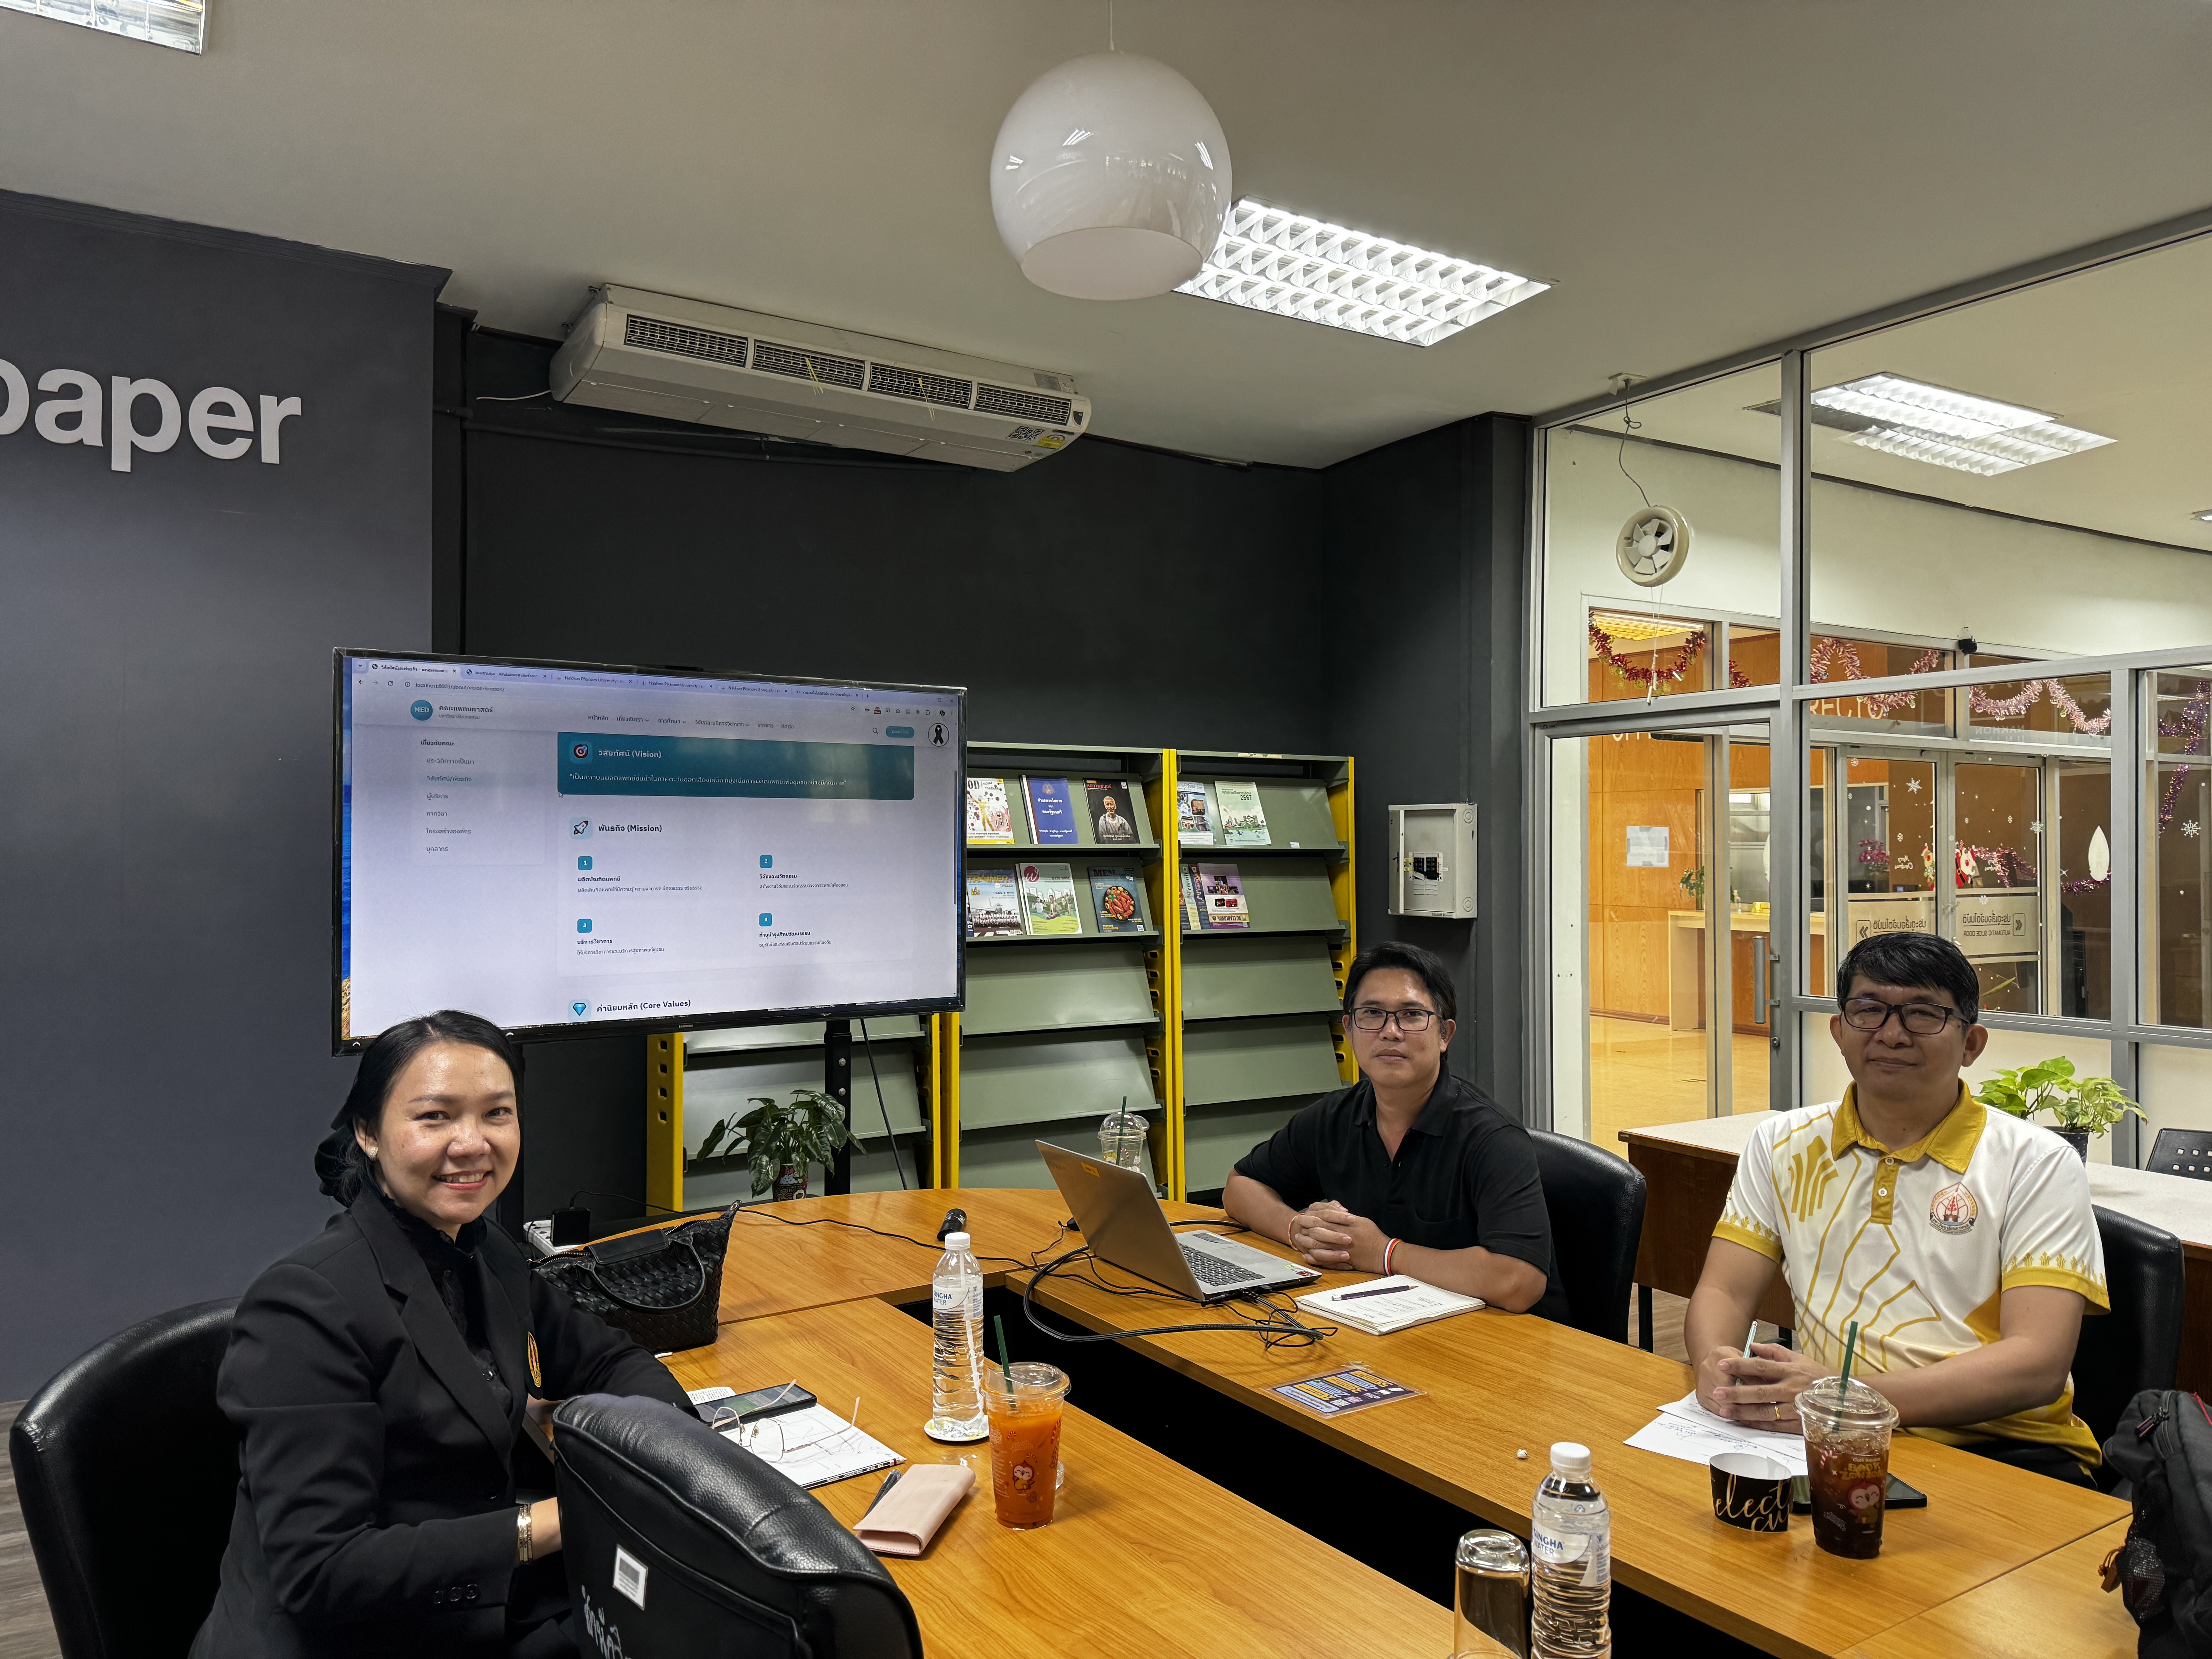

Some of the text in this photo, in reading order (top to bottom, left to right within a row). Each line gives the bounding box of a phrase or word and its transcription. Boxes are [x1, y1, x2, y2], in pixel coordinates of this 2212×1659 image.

[598, 749, 662, 759] วิสัยทัศน์ (Vision)
[598, 824, 662, 833] พันธกิจ (Mission)
[597, 999, 691, 1012] ค่านิยมหลัก (Core Values)
[1714, 1474, 1788, 1518] elect
[1534, 1528, 1564, 1550] SINGHA
